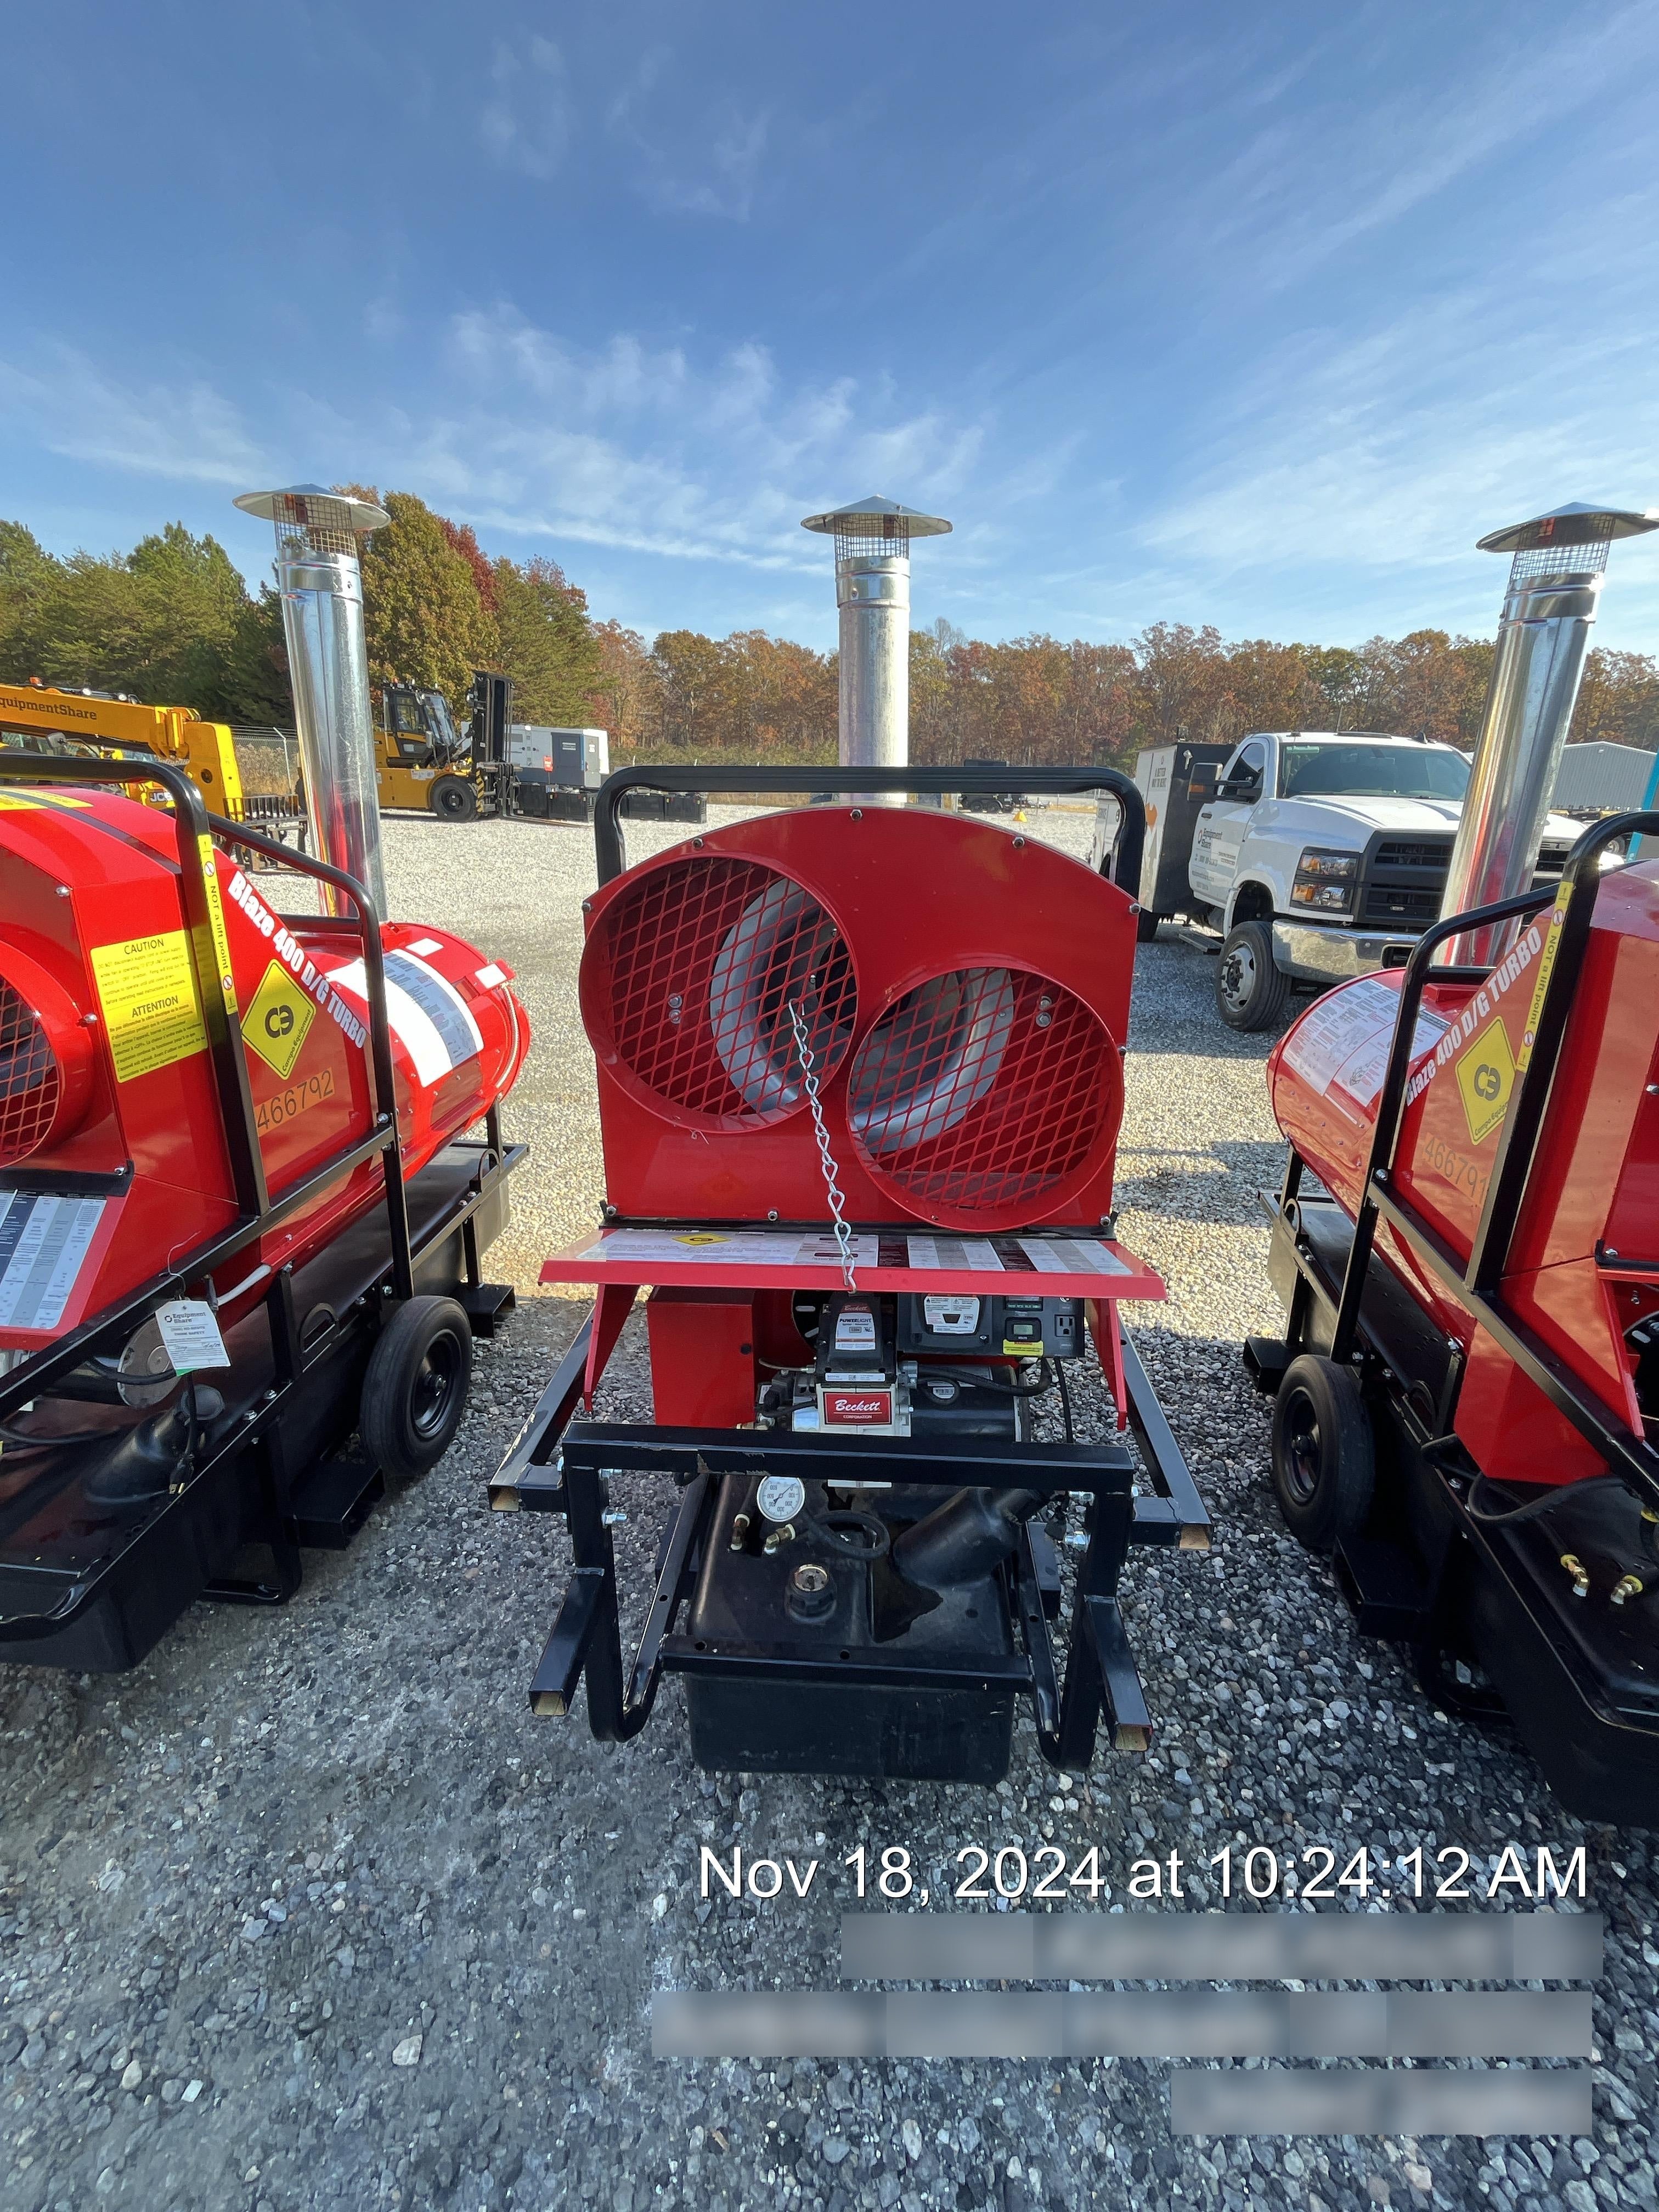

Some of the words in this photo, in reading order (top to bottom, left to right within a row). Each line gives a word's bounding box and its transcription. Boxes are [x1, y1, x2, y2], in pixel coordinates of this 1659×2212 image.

[211, 885, 219, 910] NOT
[218, 941, 228, 969] point
[124, 938, 164, 955] CAUTION
[228, 871, 274, 937] Blaze
[273, 927, 304, 972] 400
[301, 960, 330, 1005] D/G
[326, 990, 367, 1049] TURBO
[1545, 935, 1558, 962] NOT
[1435, 1024, 1462, 1066] 400
[1460, 991, 1491, 1038] D/G
[1487, 926, 1543, 1003] TURBO
[1538, 975, 1547, 992] lift
[132, 995, 178, 1018] ATTENTION
[1530, 994, 1541, 1025] point
[282, 1047, 295, 1071] Campo
[293, 1009, 312, 1046] Equipment
[257, 1070, 334, 1130] 466792
[1475, 1118, 1491, 1136] Campo
[1425, 1136, 1488, 1204] 466791
[834, 1398, 881, 1412] Beckett
